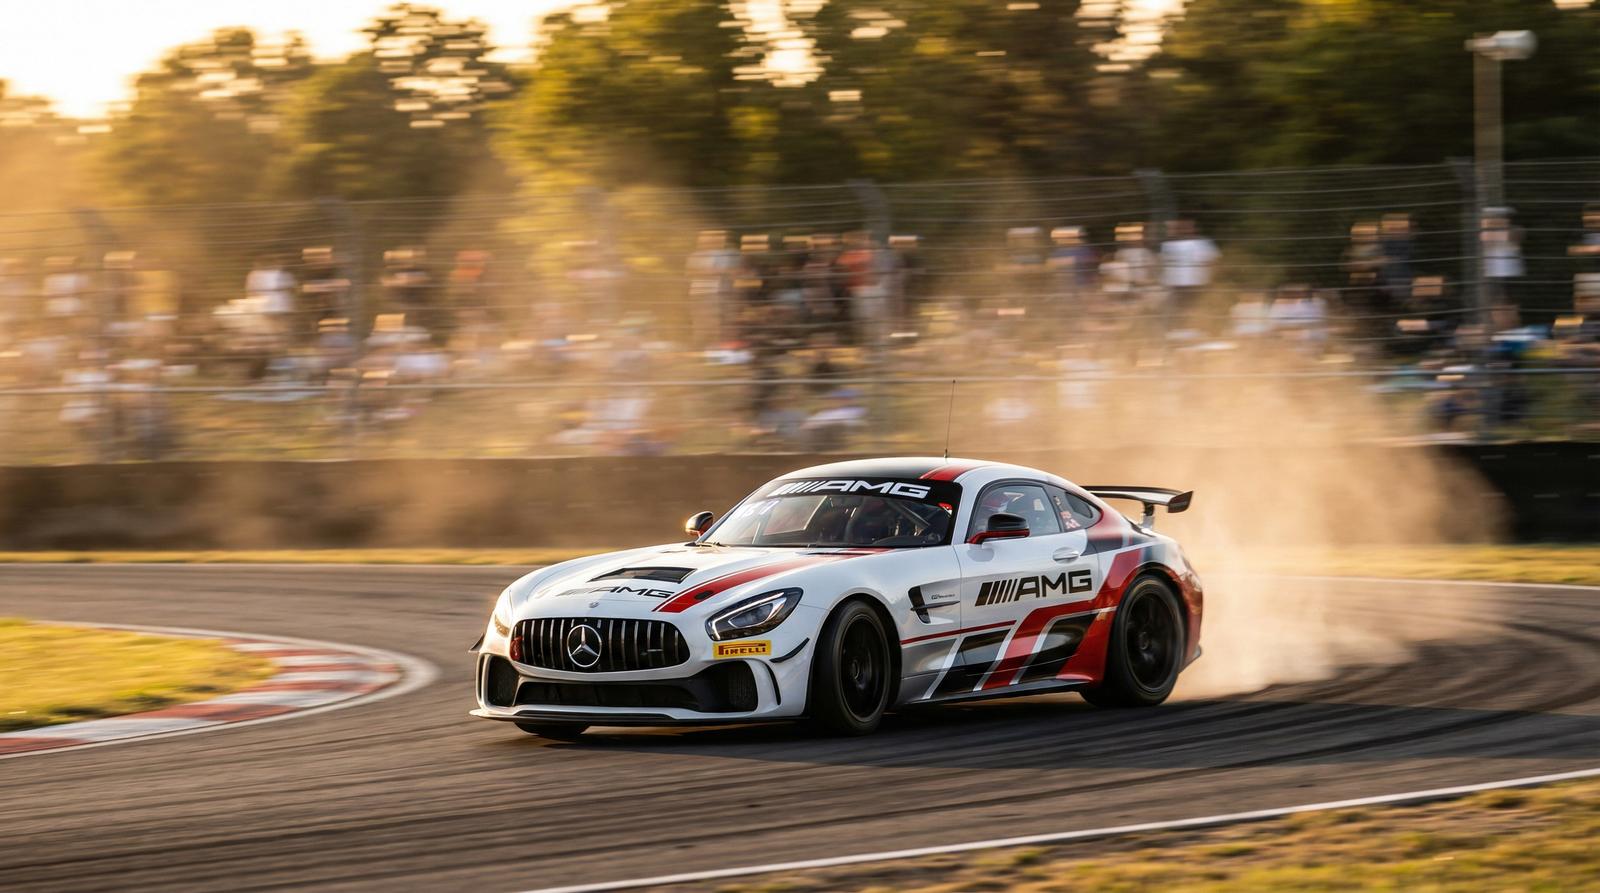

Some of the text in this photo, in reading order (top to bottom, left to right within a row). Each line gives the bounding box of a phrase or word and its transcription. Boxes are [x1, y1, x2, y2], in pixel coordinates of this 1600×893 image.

[810, 480, 931, 499] AMG
[588, 586, 675, 598] AMG
[1014, 569, 1092, 602] AMG
[718, 643, 766, 655] PIRELLI
